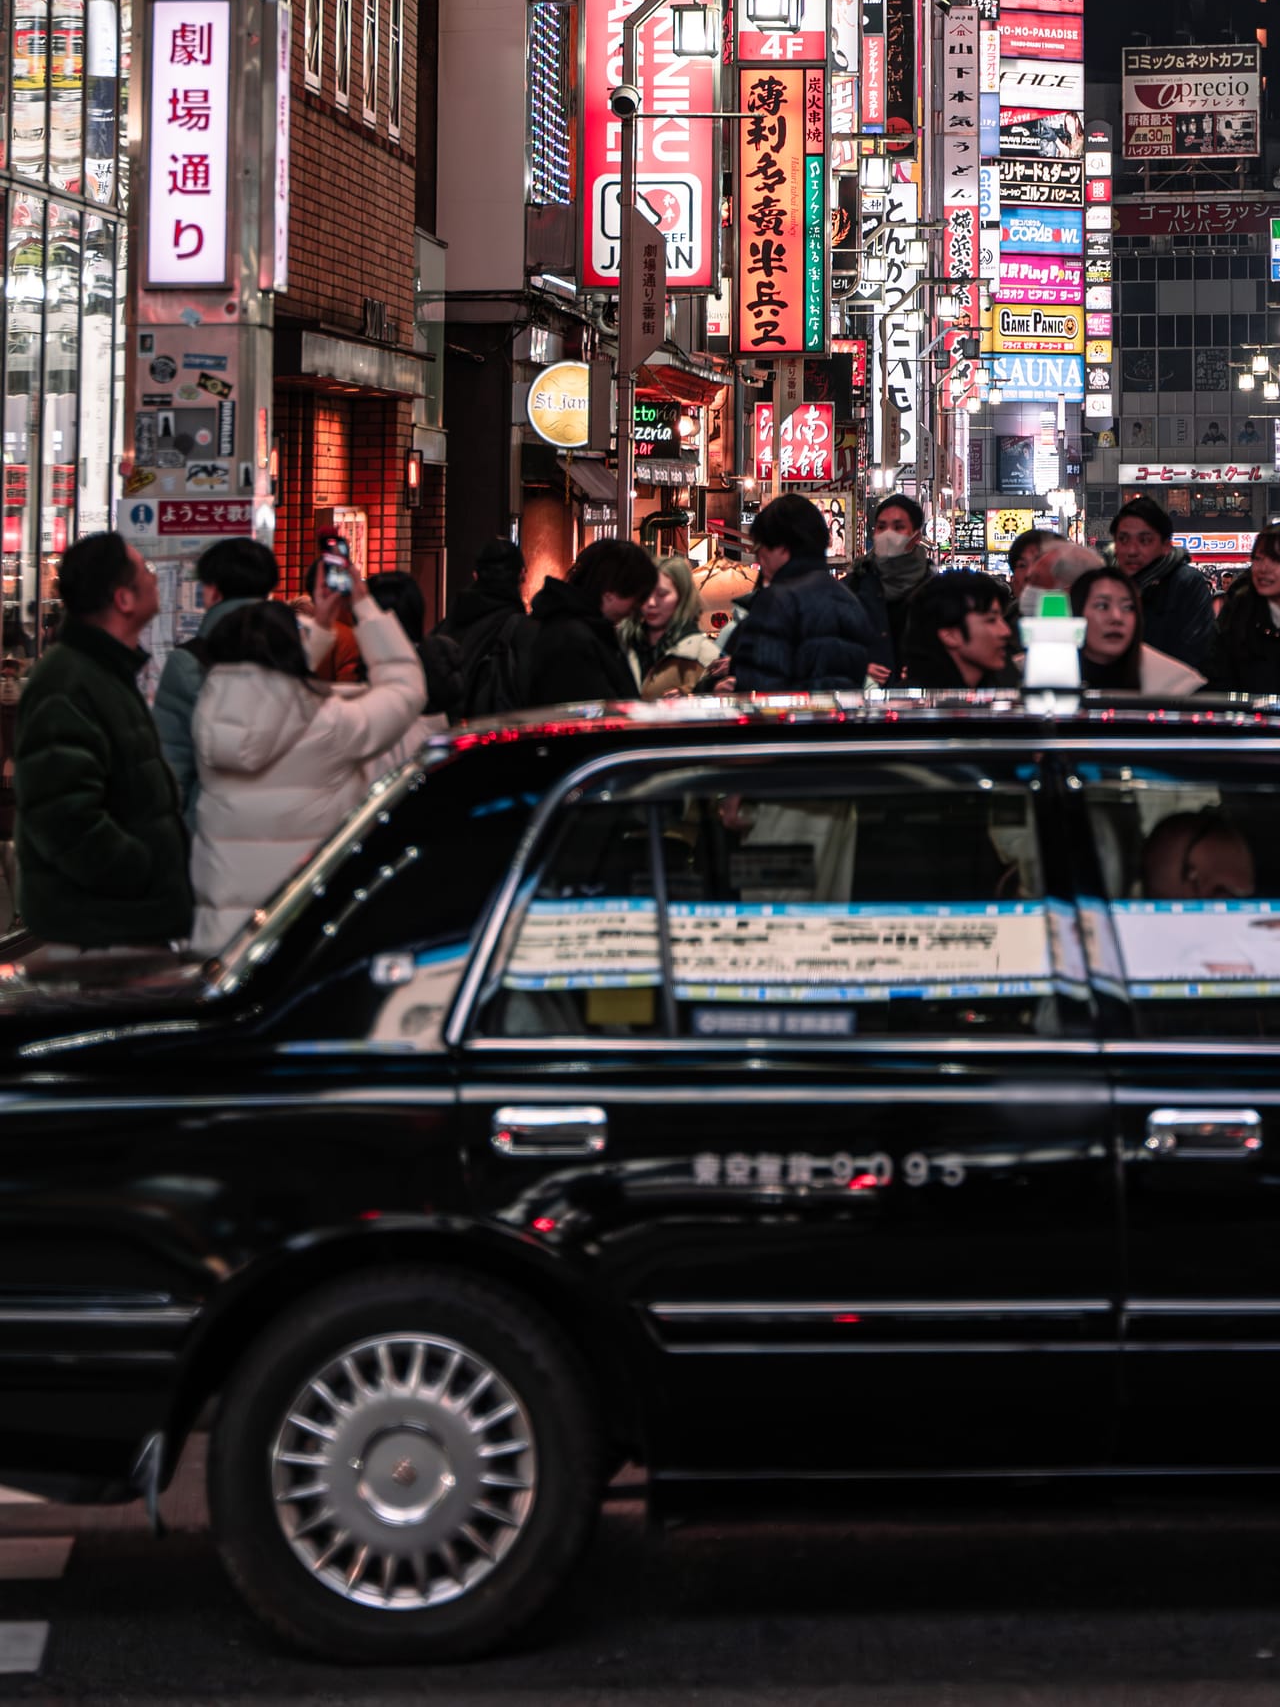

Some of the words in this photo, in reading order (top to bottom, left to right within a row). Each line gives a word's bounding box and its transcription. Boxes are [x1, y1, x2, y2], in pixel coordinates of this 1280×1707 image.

[760, 36, 805, 60] 4F
[1127, 53, 1255, 69] コミック&ネットカフェ
[807, 78, 822, 143] 炭火串焼
[948, 45, 974, 198] 山下本気うどん
[167, 22, 213, 261] 劇場通り
[1168, 219, 1238, 233] ハンバーグ
[642, 244, 657, 335] 劇場通り一番街
[1001, 311, 1030, 333] GAME
[1033, 311, 1064, 334] PANIC
[993, 357, 1083, 387] SAUNA
